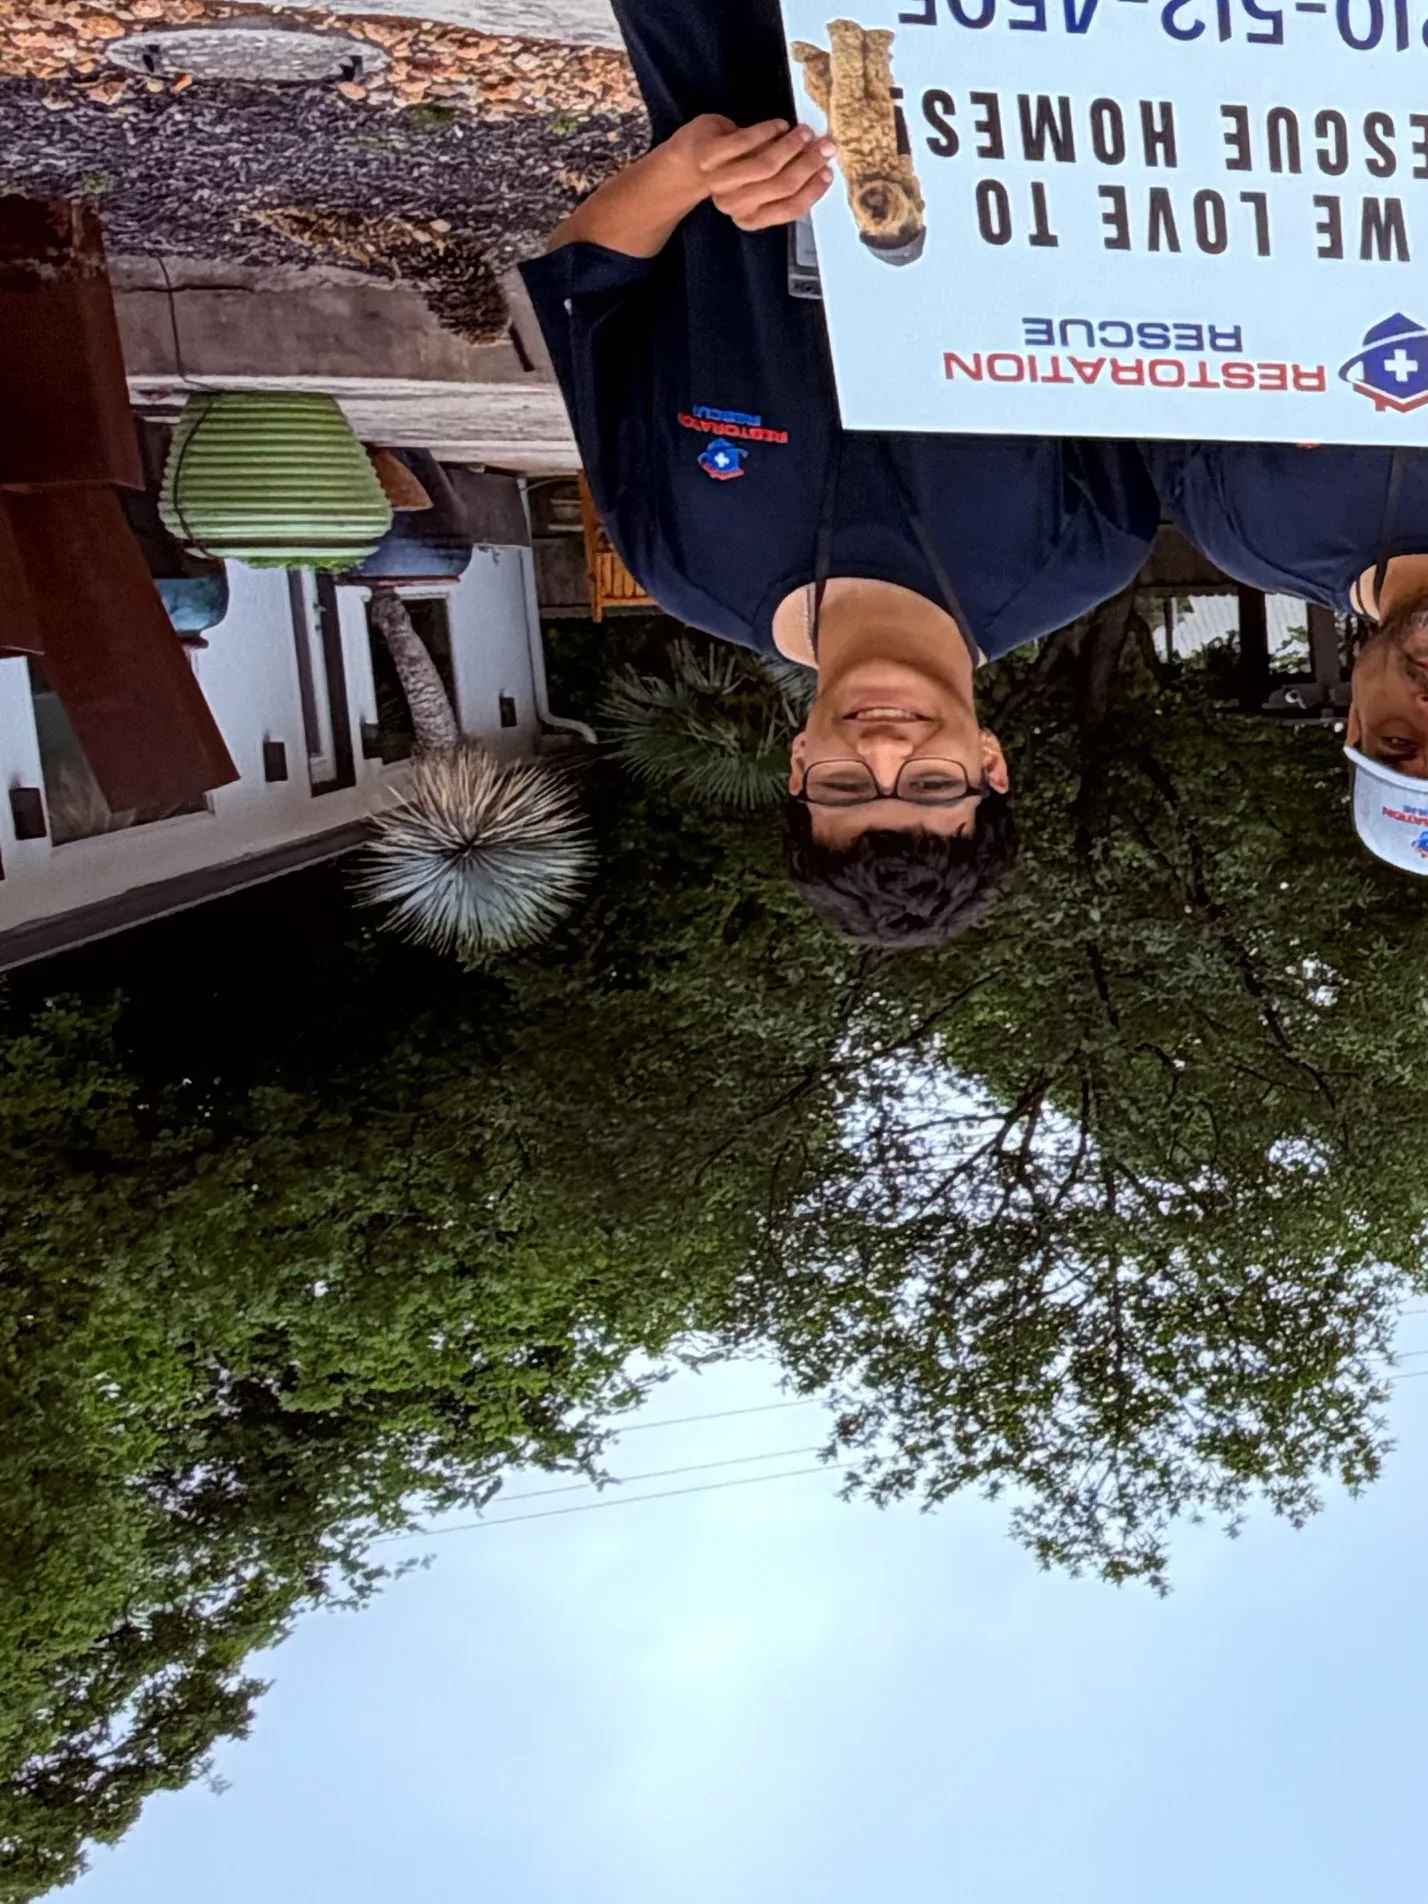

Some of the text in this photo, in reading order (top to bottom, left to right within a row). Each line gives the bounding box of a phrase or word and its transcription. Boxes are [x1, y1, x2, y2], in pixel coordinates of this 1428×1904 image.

[888, 87, 1176, 167] HOMES!
[975, 179, 1410, 262] WE LOVE TO
[1021, 317, 1243, 353] RESCUE
[943, 352, 1326, 392] RESTORATION
